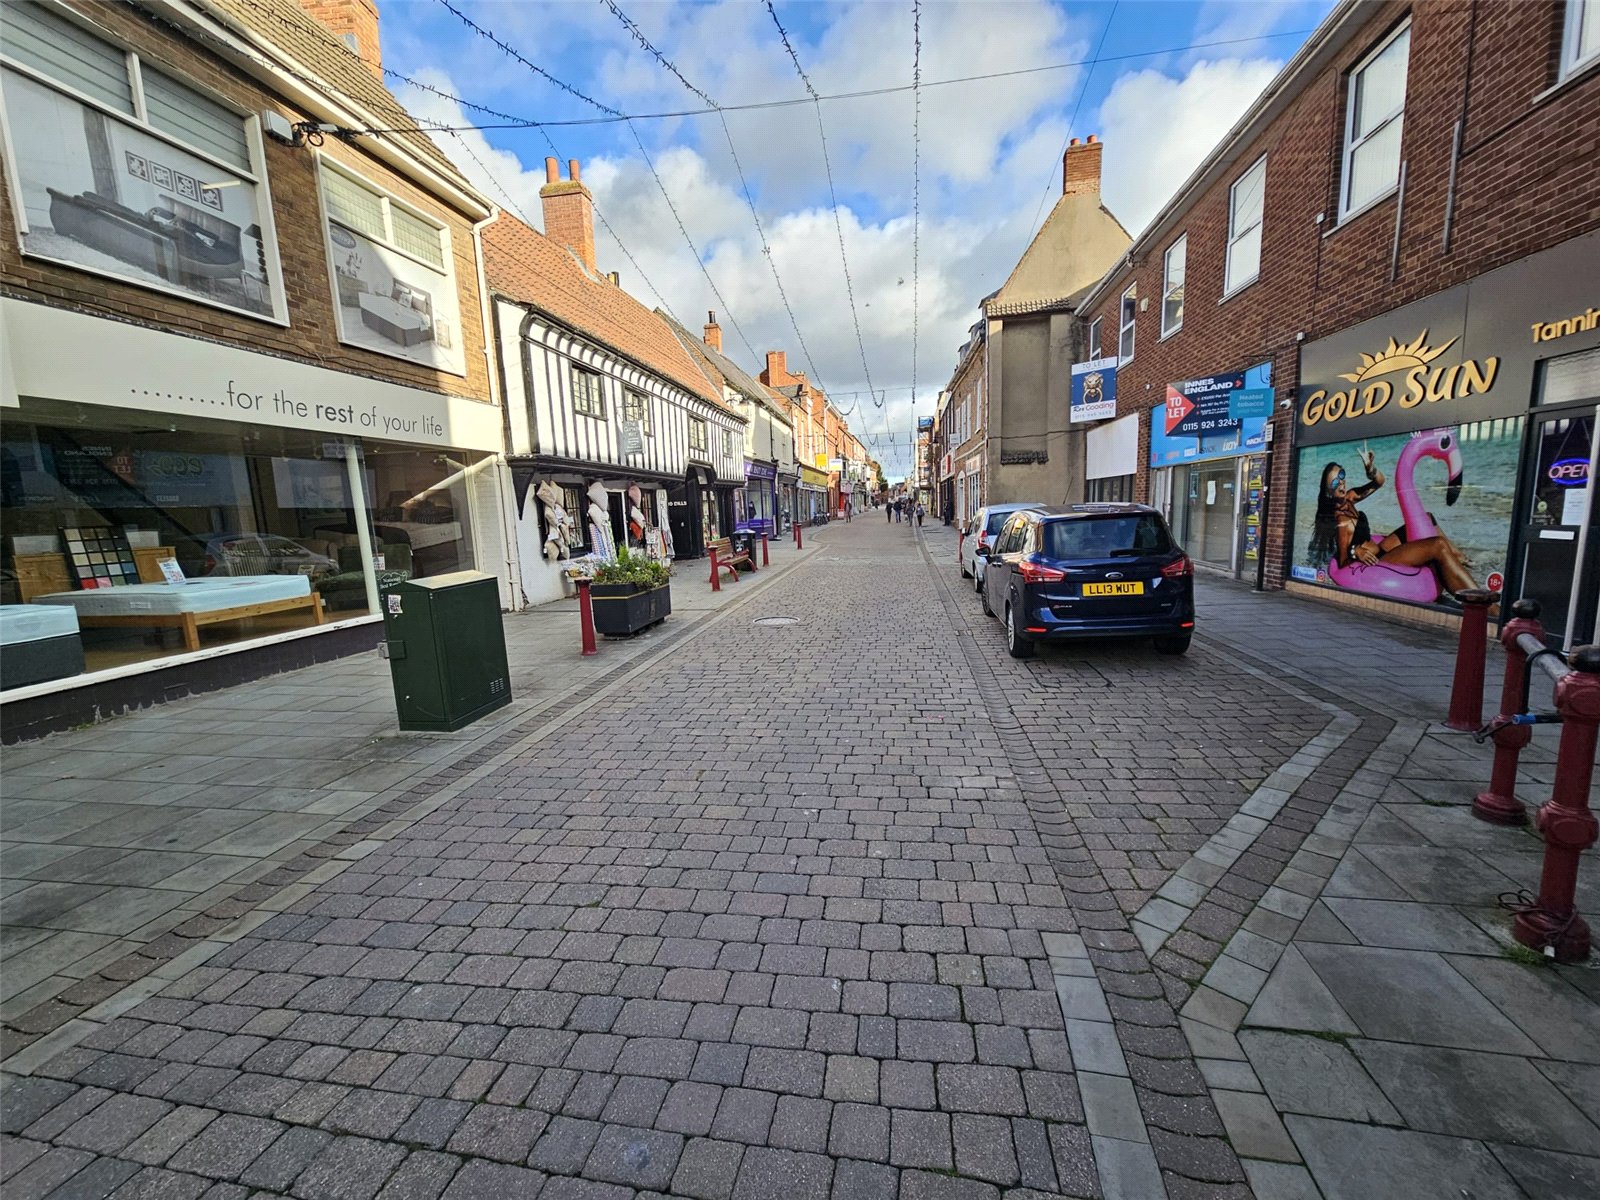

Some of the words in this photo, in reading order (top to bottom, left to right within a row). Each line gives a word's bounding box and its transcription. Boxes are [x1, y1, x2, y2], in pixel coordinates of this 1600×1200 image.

[1184, 378, 1214, 388] INNES
[1184, 382, 1233, 395] ENGLAND
[1302, 380, 1391, 426] GOLD
[1399, 356, 1499, 408] SUN
[1085, 403, 1114, 411] Gooding
[1170, 396, 1182, 407] TO
[273, 390, 308, 418] the
[315, 404, 354, 423] rest
[360, 406, 378, 427] of
[383, 414, 417, 435] your
[422, 414, 443, 437] life
[1168, 407, 1186, 418] LET
[1183, 422, 1198, 431] 0115
[1201, 420, 1215, 429] 924
[1218, 418, 1238, 427] 3243
[1089, 584, 1113, 595] LL13
[1116, 583, 1137, 593] WUT
